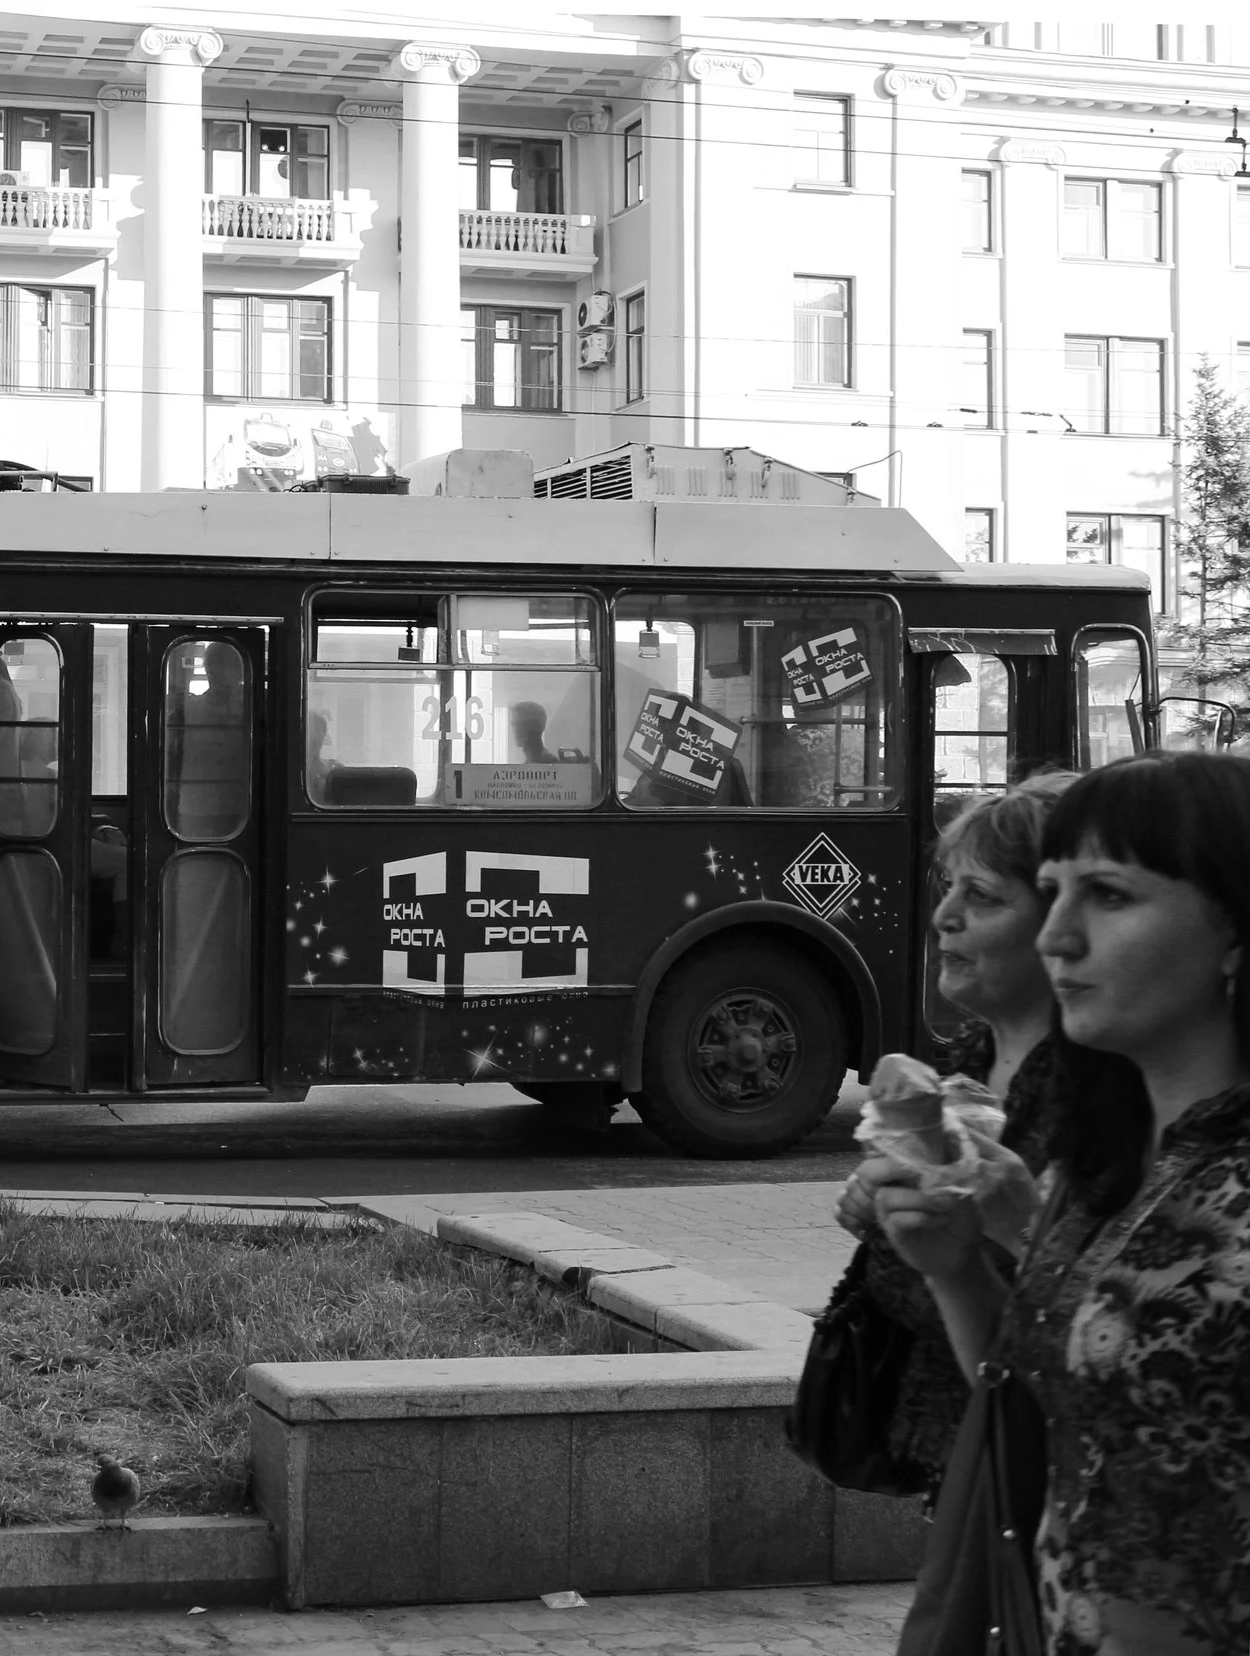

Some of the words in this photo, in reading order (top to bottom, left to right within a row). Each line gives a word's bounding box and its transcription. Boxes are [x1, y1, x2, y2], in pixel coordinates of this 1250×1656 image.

[815, 647, 849, 666] ОКНА
[825, 652, 865, 674] РОСТА
[788, 667, 803, 679] ОКНА
[793, 673, 815, 687] РОСТА
[422, 696, 486, 741] 216
[640, 712, 660, 727] ОКНА
[640, 723, 664, 743] РОСТА
[676, 727, 714, 751] ОКНА
[679, 742, 725, 770] РОСТА
[454, 769, 462, 799] 1
[798, 865, 847, 885] VEKA
[384, 903, 424, 921] ОКНА
[466, 898, 553, 918] ОКНА
[390, 927, 446, 948] РОСТА
[484, 925, 589, 945] РОСТА
[463, 994, 553, 1010] пластиковые
[561, 991, 589, 1000] окна
